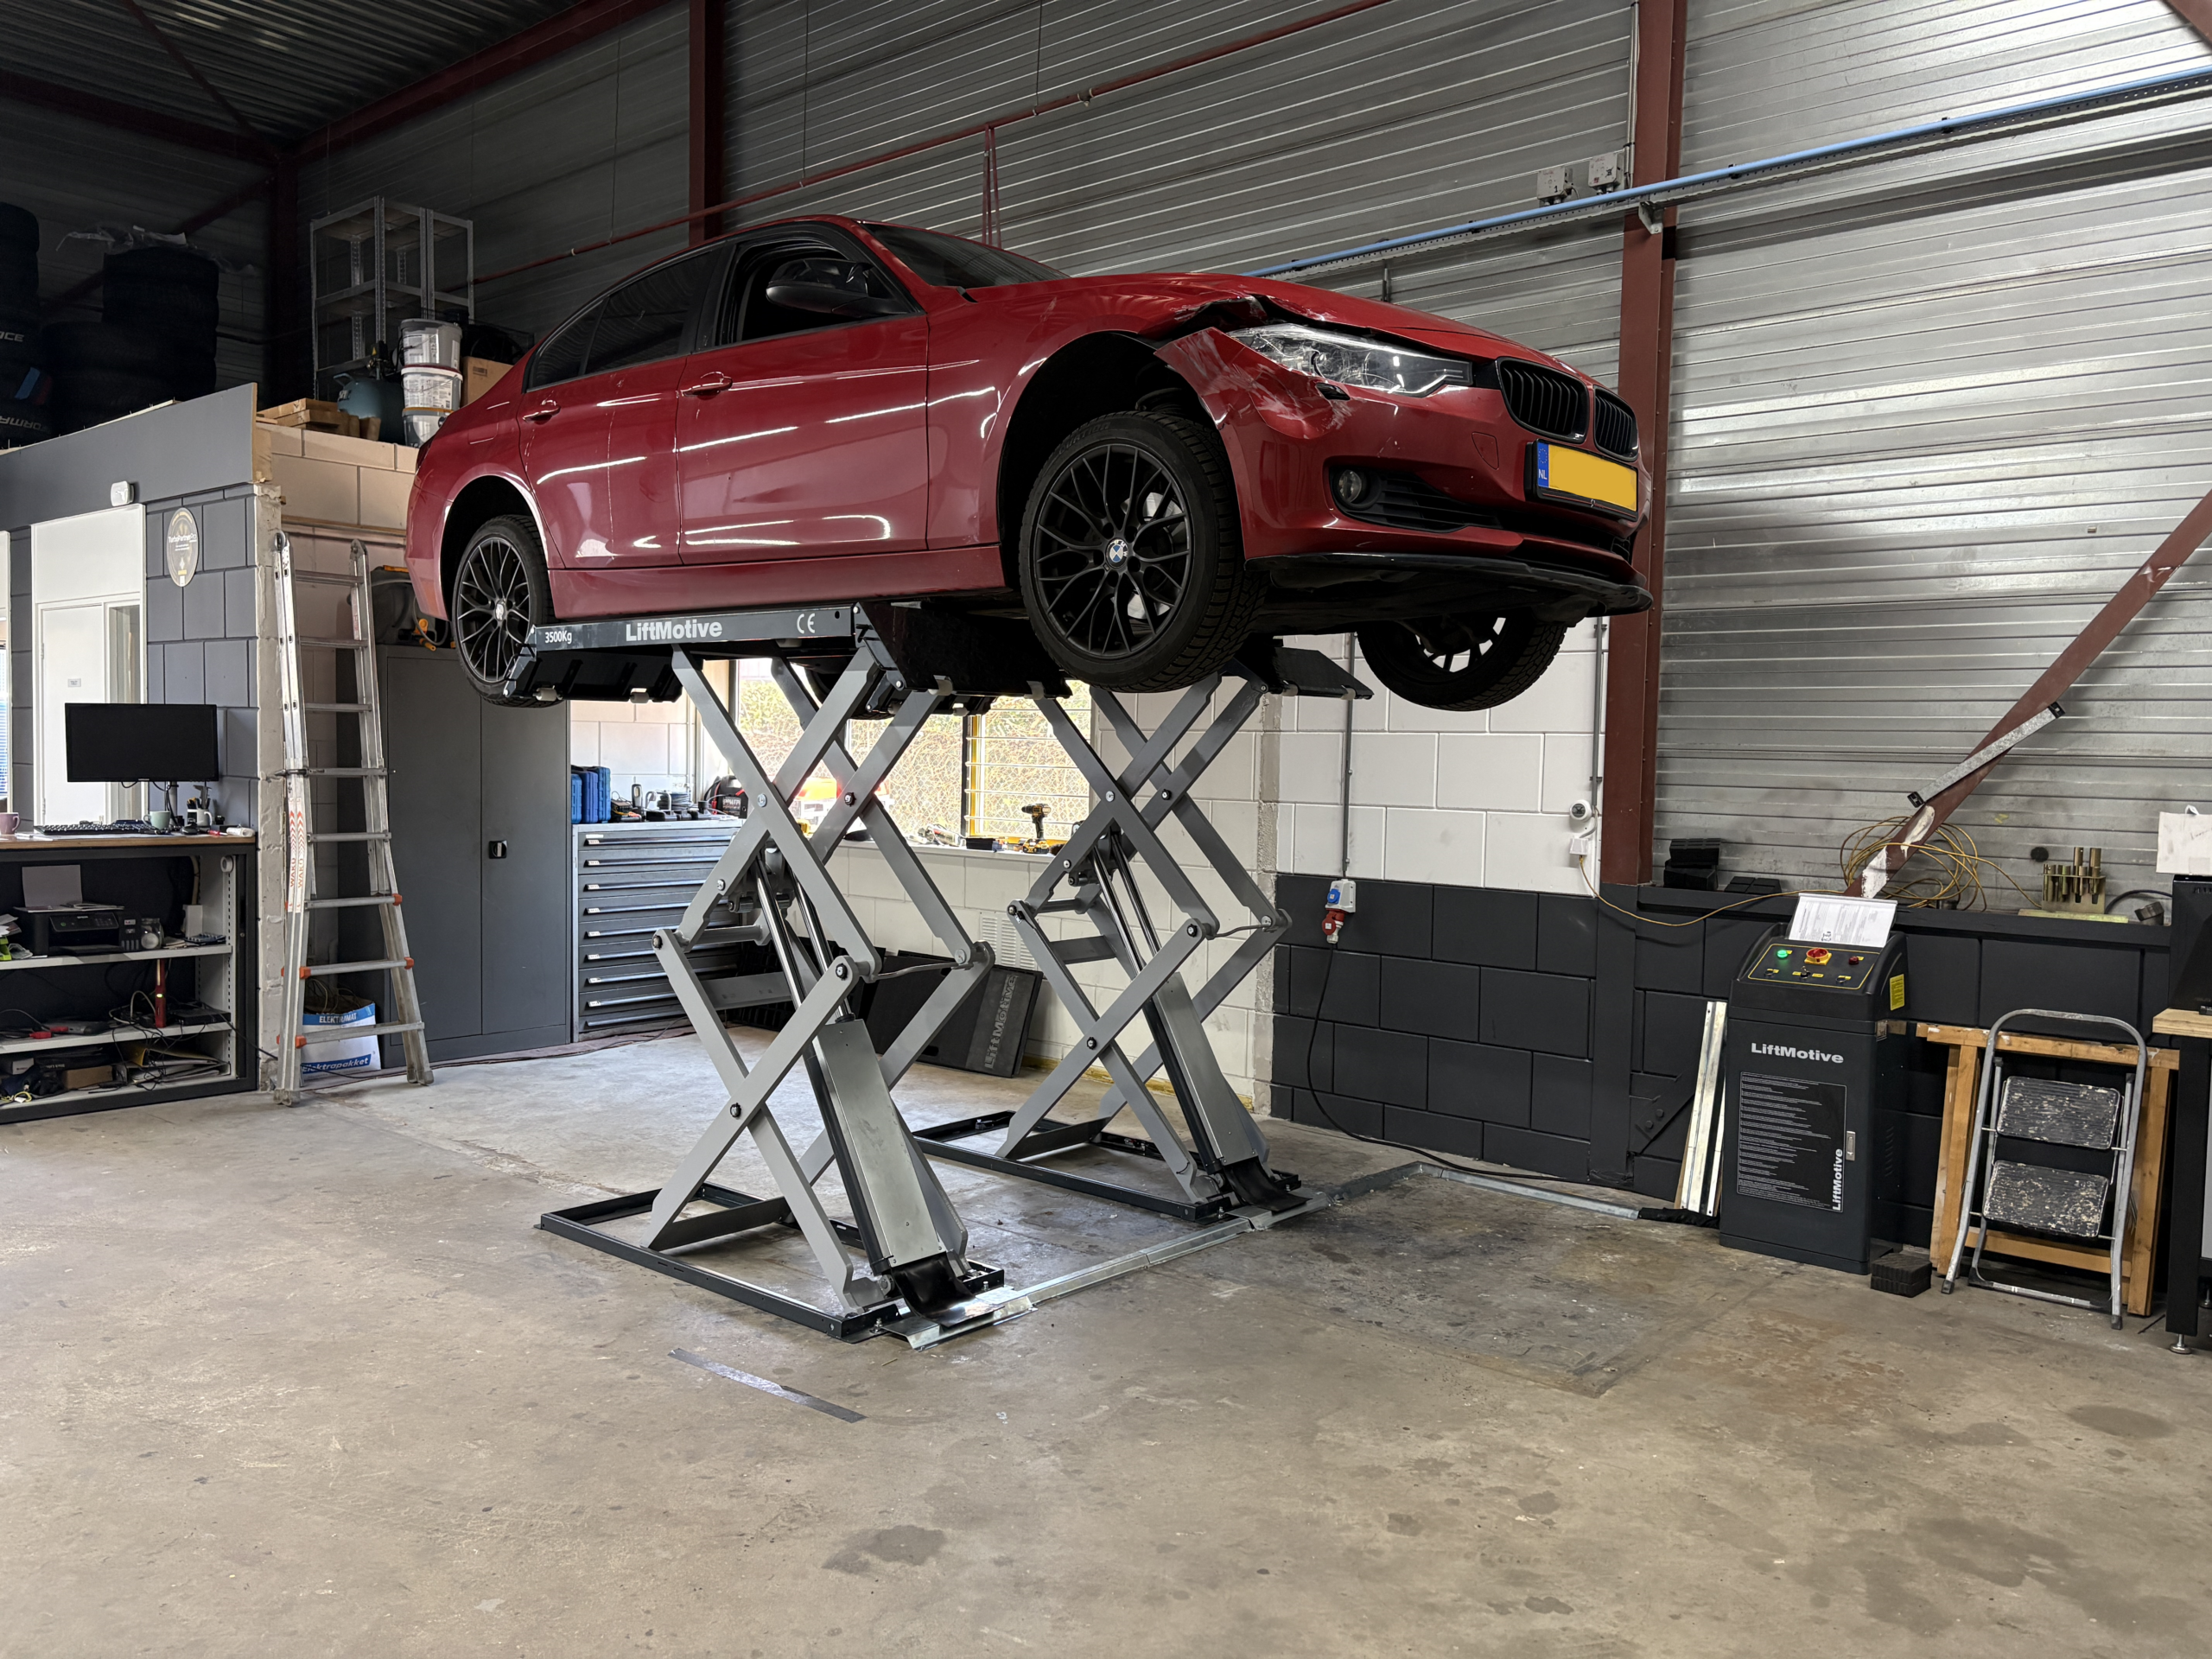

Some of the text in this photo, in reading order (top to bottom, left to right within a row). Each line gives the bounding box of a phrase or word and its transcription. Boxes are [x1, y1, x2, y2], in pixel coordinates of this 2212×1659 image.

[1538, 468, 1548, 480] NL
[544, 630, 572, 645] 3500Kg
[626, 619, 722, 642] LiftMotive
[984, 974, 1019, 1069] LiftMotive
[1751, 1042, 1845, 1064] LiftMotive
[1832, 1148, 1843, 1211] LiftMotive
